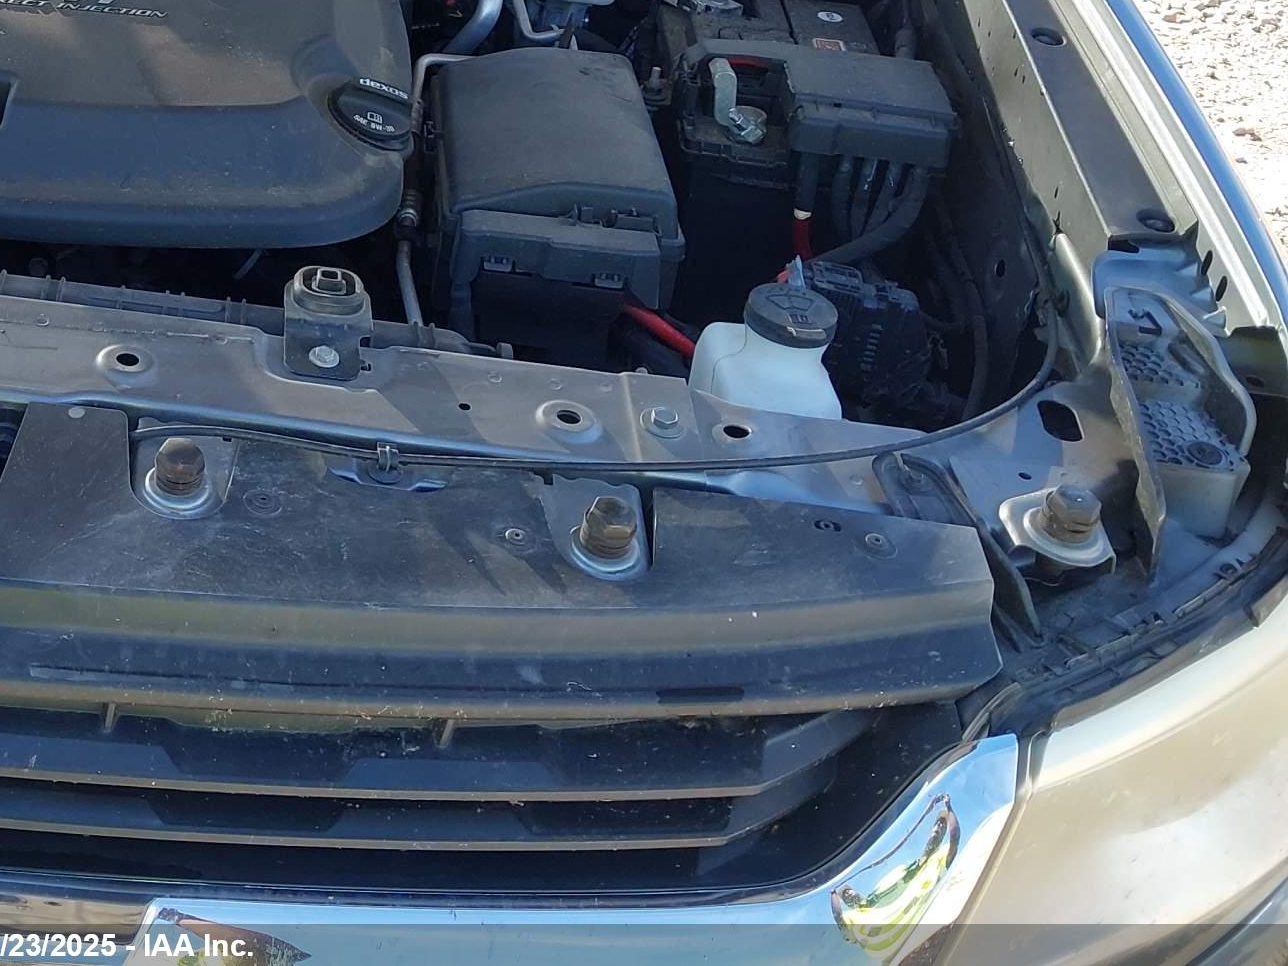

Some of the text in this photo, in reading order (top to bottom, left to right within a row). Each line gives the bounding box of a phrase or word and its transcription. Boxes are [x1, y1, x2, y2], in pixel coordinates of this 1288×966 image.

[57, 2, 169, 18] INJECTION
[359, 77, 409, 99] dexos
[353, 114, 369, 126] SAE
